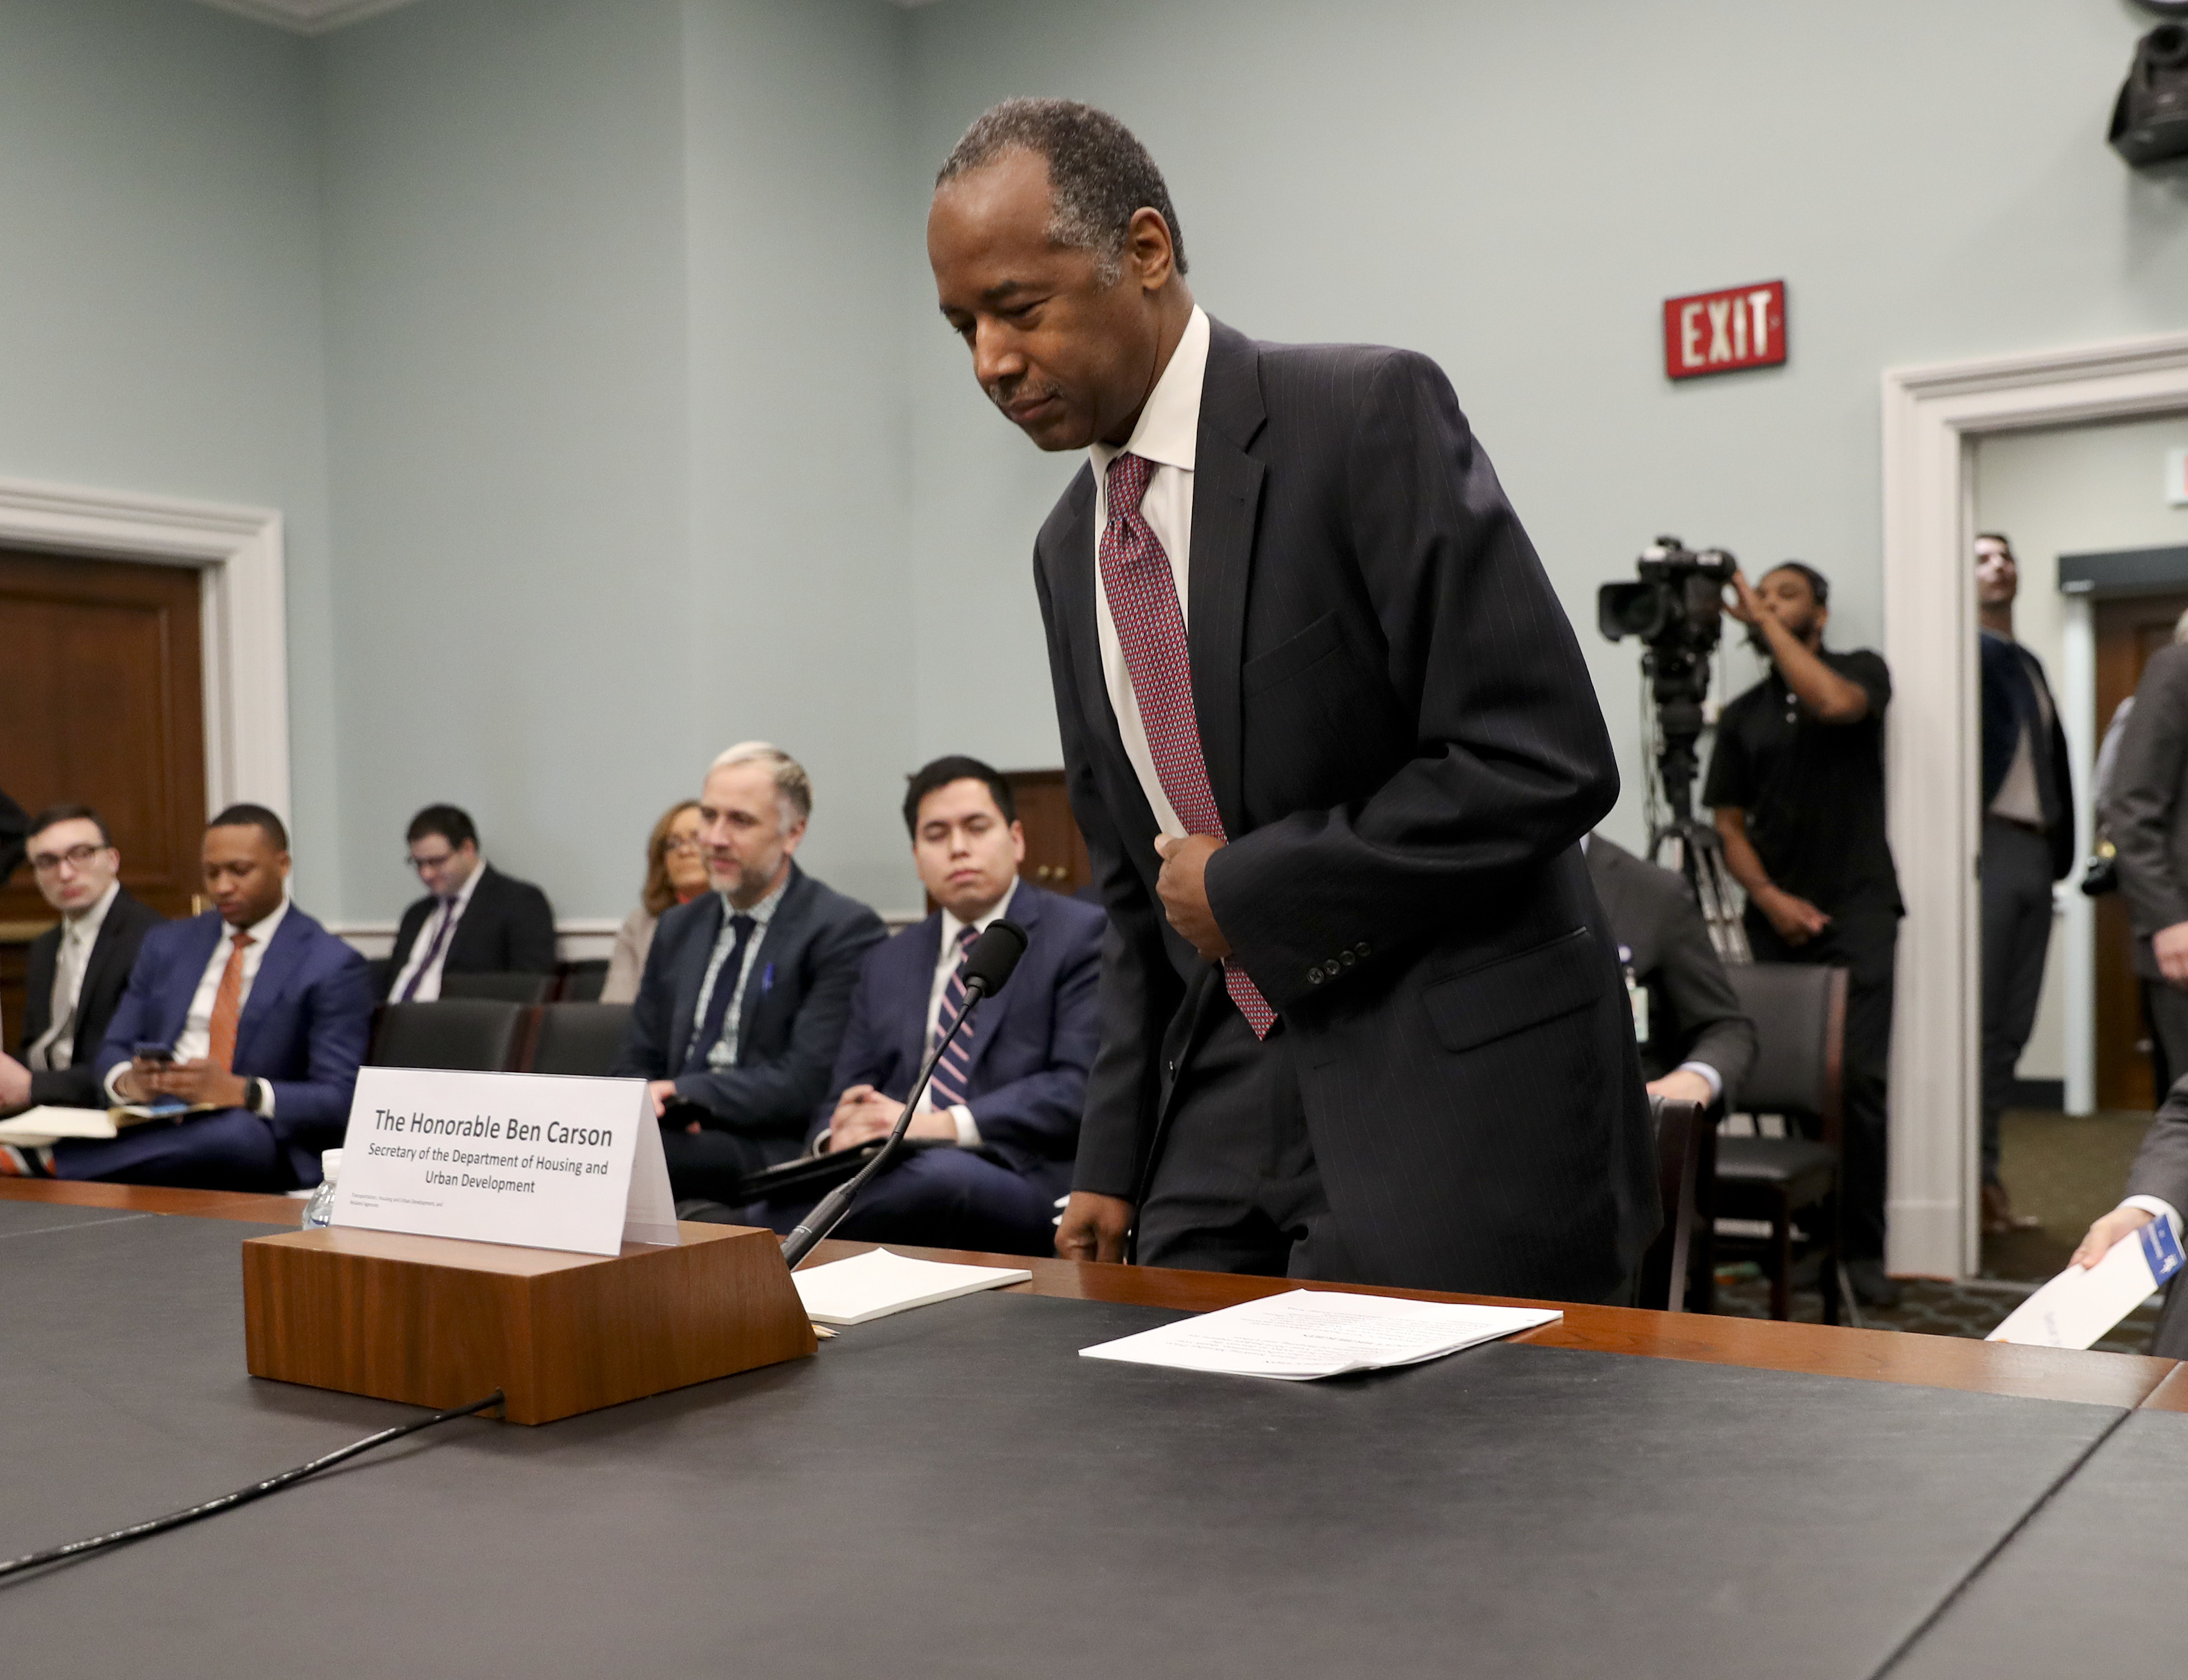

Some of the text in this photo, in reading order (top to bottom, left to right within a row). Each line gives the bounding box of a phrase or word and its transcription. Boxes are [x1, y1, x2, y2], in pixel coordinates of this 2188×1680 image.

[1681, 290, 1772, 368] EXIT
[375, 1109, 613, 1146] The Honorable Ben Carson
[368, 1142, 609, 1177] Secretary of the Department of Housing and
[425, 1170, 535, 1194] Urban Development
